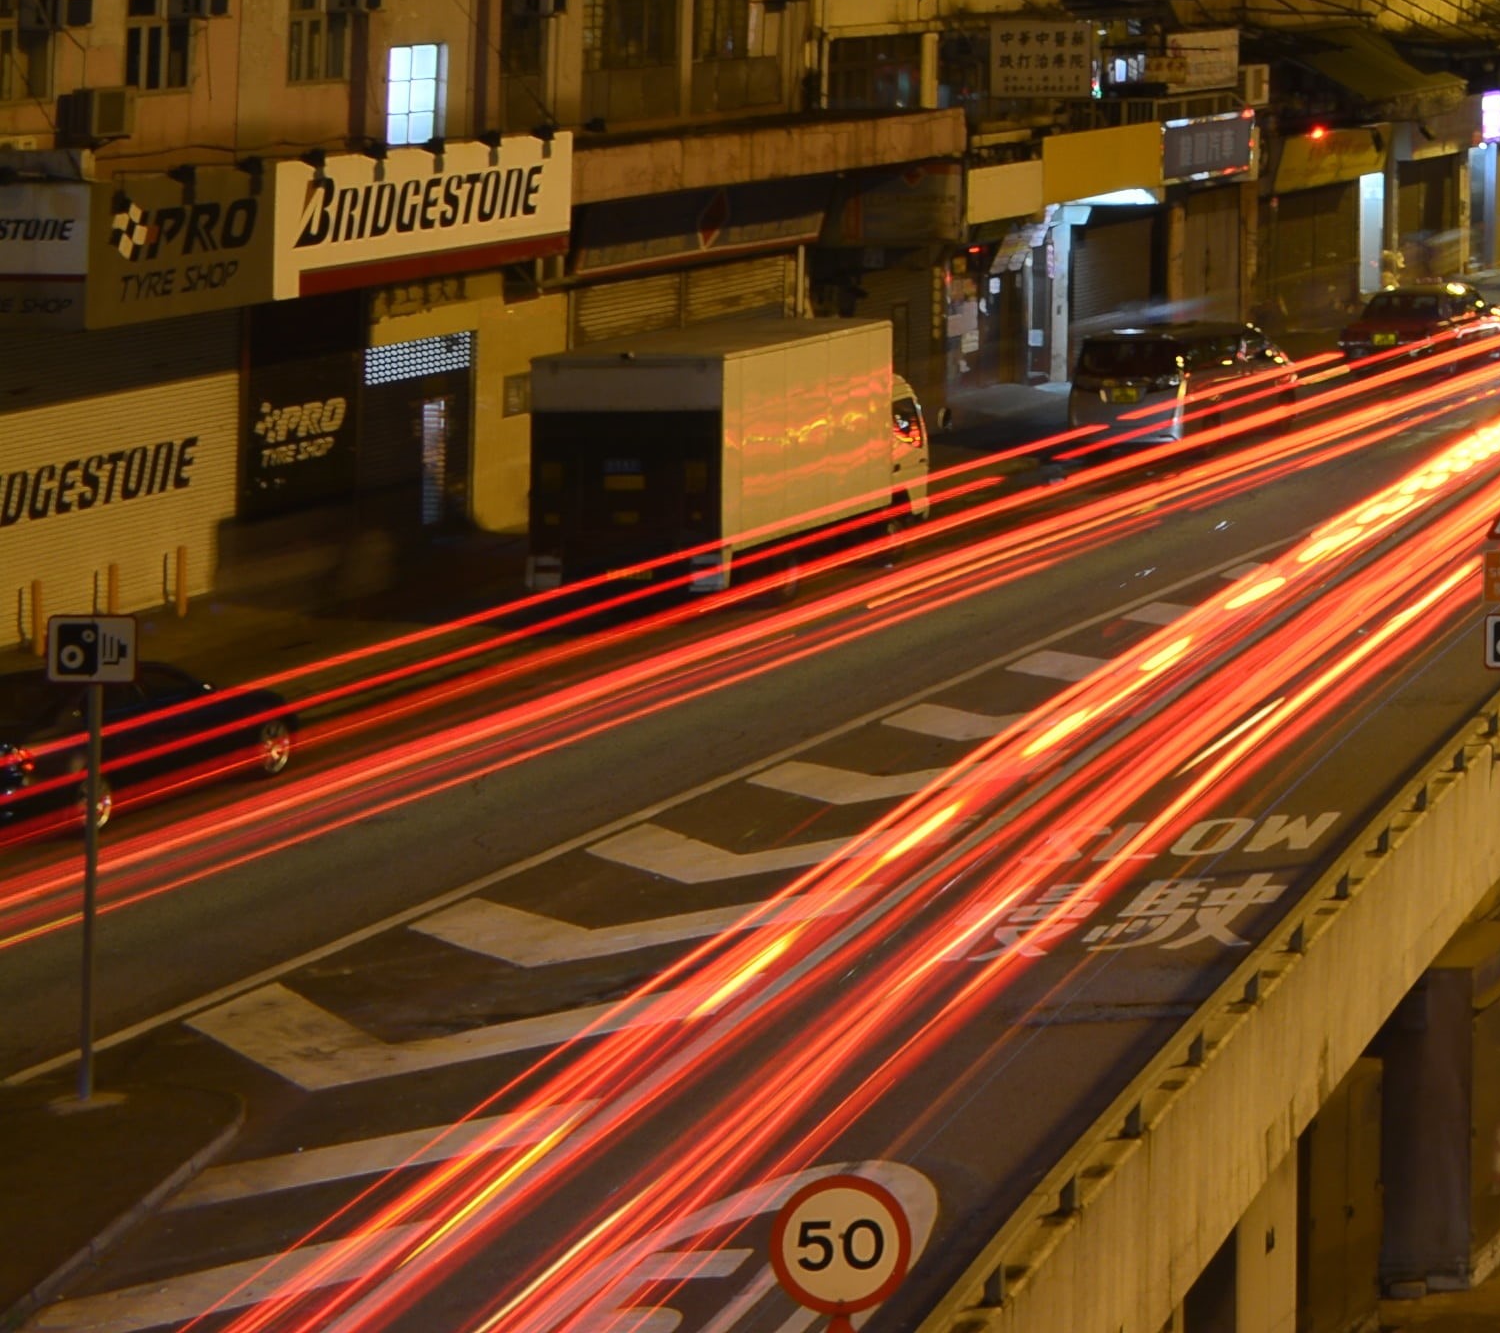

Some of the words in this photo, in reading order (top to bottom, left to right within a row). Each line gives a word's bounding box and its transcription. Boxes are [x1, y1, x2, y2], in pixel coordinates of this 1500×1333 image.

[146, 196, 259, 261] PRO
[293, 165, 545, 249] BRIDGESTONE
[19, 299, 73, 314] SHOP
[120, 268, 177, 302] TYRE
[180, 261, 239, 294] SHOP
[275, 397, 347, 441] PRO
[0, 437, 198, 528] DGESTONE
[1021, 811, 1342, 865] SLOW
[797, 1218, 885, 1273] 50
